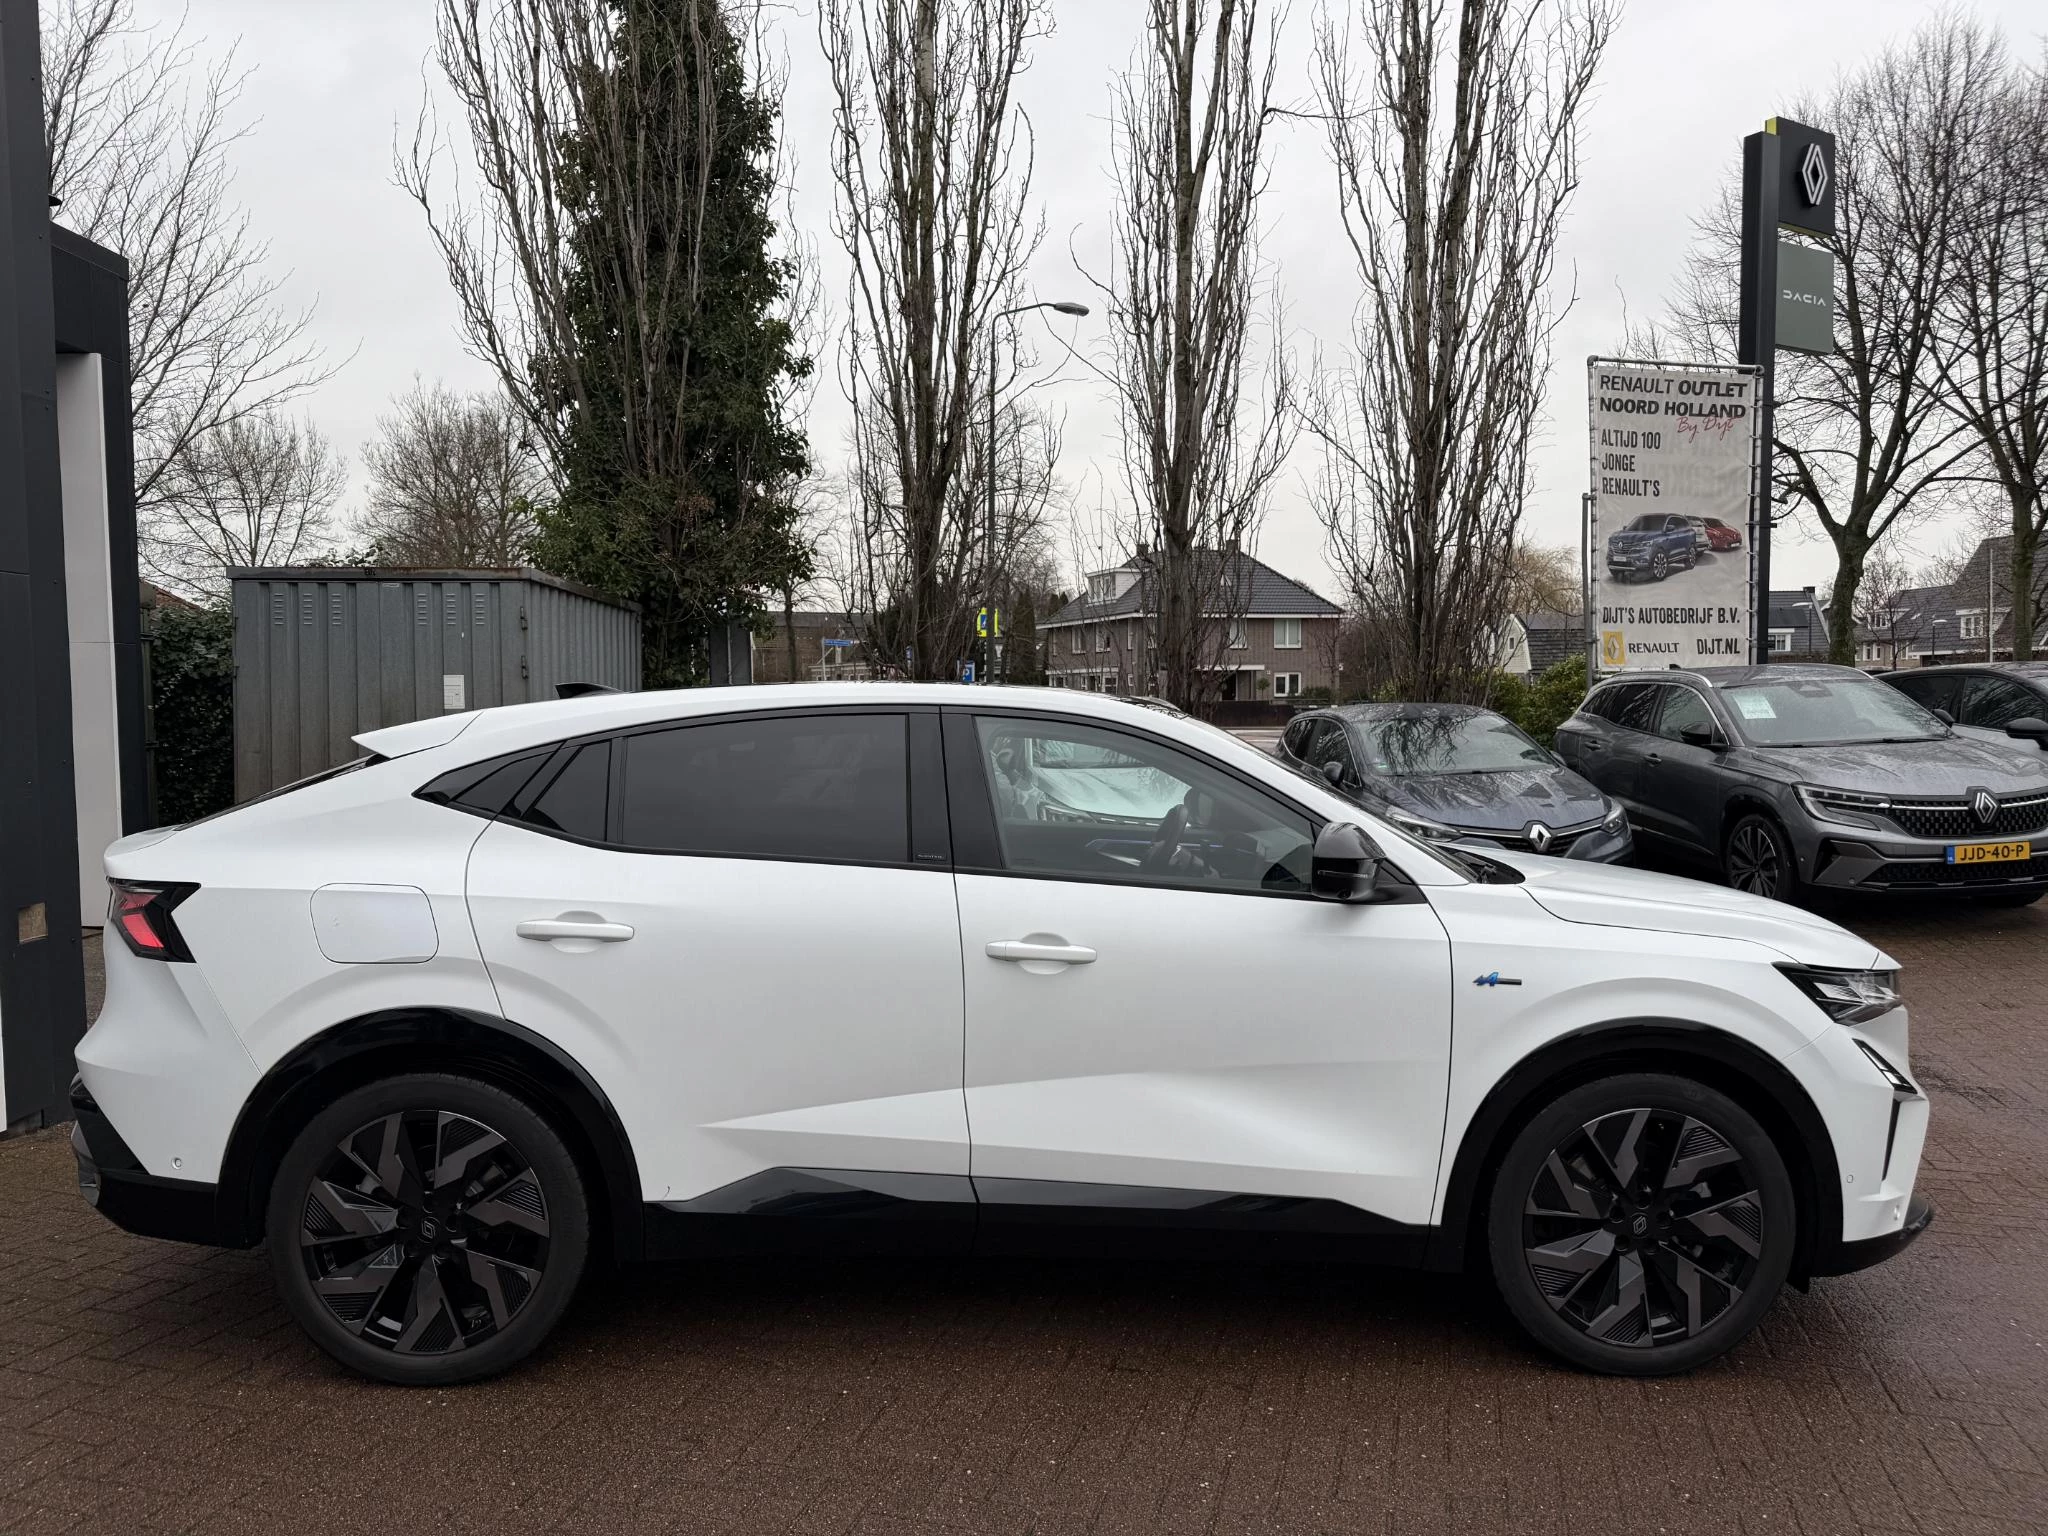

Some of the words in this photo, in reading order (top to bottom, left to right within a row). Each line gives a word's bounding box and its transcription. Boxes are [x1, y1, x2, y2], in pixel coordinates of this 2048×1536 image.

[1783, 289, 1826, 307] DACIA
[1600, 374, 1675, 394] RENAULT
[1678, 379, 1748, 398] OUTLET
[1600, 397, 1660, 415] NOORD
[1664, 401, 1746, 418] HOLLAND
[1601, 429, 1638, 448] ALTIJD
[1641, 431, 1661, 449] 100
[1676, 416, 1698, 443] By
[1602, 453, 1636, 472] JONGE
[1602, 477, 1660, 497] RENAULT'S
[1602, 606, 1635, 624] DIJT'S
[1638, 607, 1714, 624] AUTOBEDRIJF
[1717, 607, 1741, 624] B.V.
[1628, 642, 1680, 654] RENAULT
[1697, 638, 1741, 655] DIJT.NL
[1960, 844, 2024, 861] JJD-40-P
